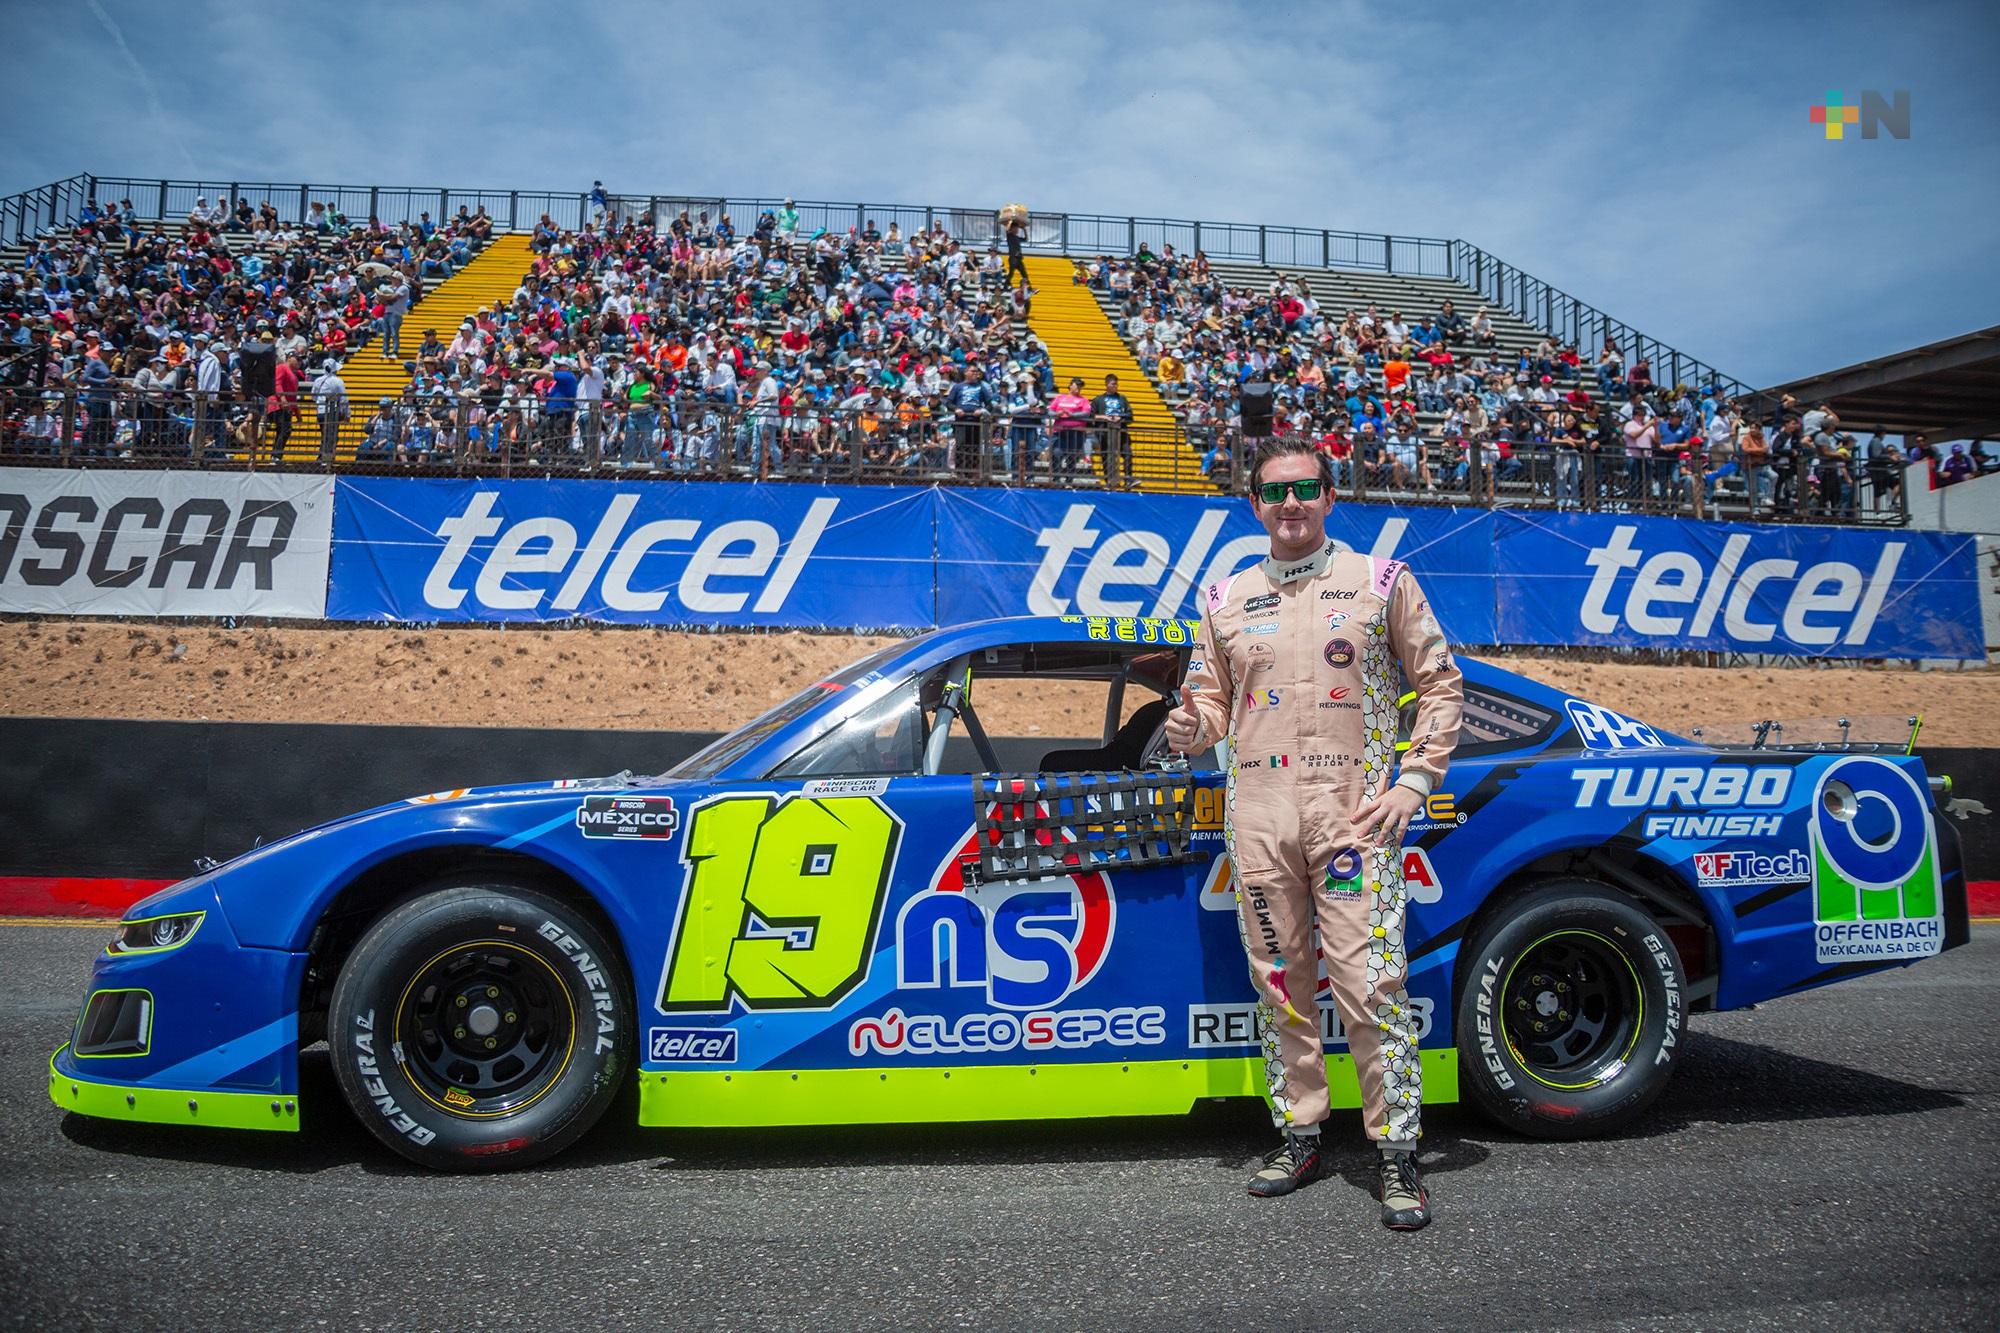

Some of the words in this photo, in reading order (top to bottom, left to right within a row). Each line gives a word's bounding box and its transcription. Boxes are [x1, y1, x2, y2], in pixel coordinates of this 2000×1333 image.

[423, 492, 840, 613] telcel
[1285, 562, 1314, 578] HRX
[1320, 589, 1358, 600] telcel
[1580, 525, 1906, 645] telcel
[1571, 706, 1656, 748] PPG
[1240, 760, 1262, 770] HRX
[619, 801, 646, 809] NASCAR
[1571, 768, 1793, 807] TURBO
[581, 809, 674, 826] MÉXICO
[1646, 815, 1784, 836] FINISH
[658, 794, 903, 1012] 19
[1819, 921, 1938, 941] OFFENBACH
[1820, 944, 1883, 956] MEXICANA
[1886, 943, 1904, 953] SA
[1907, 942, 1920, 952] DE
[1923, 941, 1936, 952] CV
[537, 920, 615, 1056] GENERAL
[1643, 934, 1681, 1065] GENERAL
[852, 1011, 1018, 1051] NÚCLEO
[1025, 1010, 1162, 1046] SEPEC
[1476, 956, 1515, 1090] GENERAL
[652, 1034, 727, 1058] telcel
[355, 1008, 437, 1147] GENERAL
